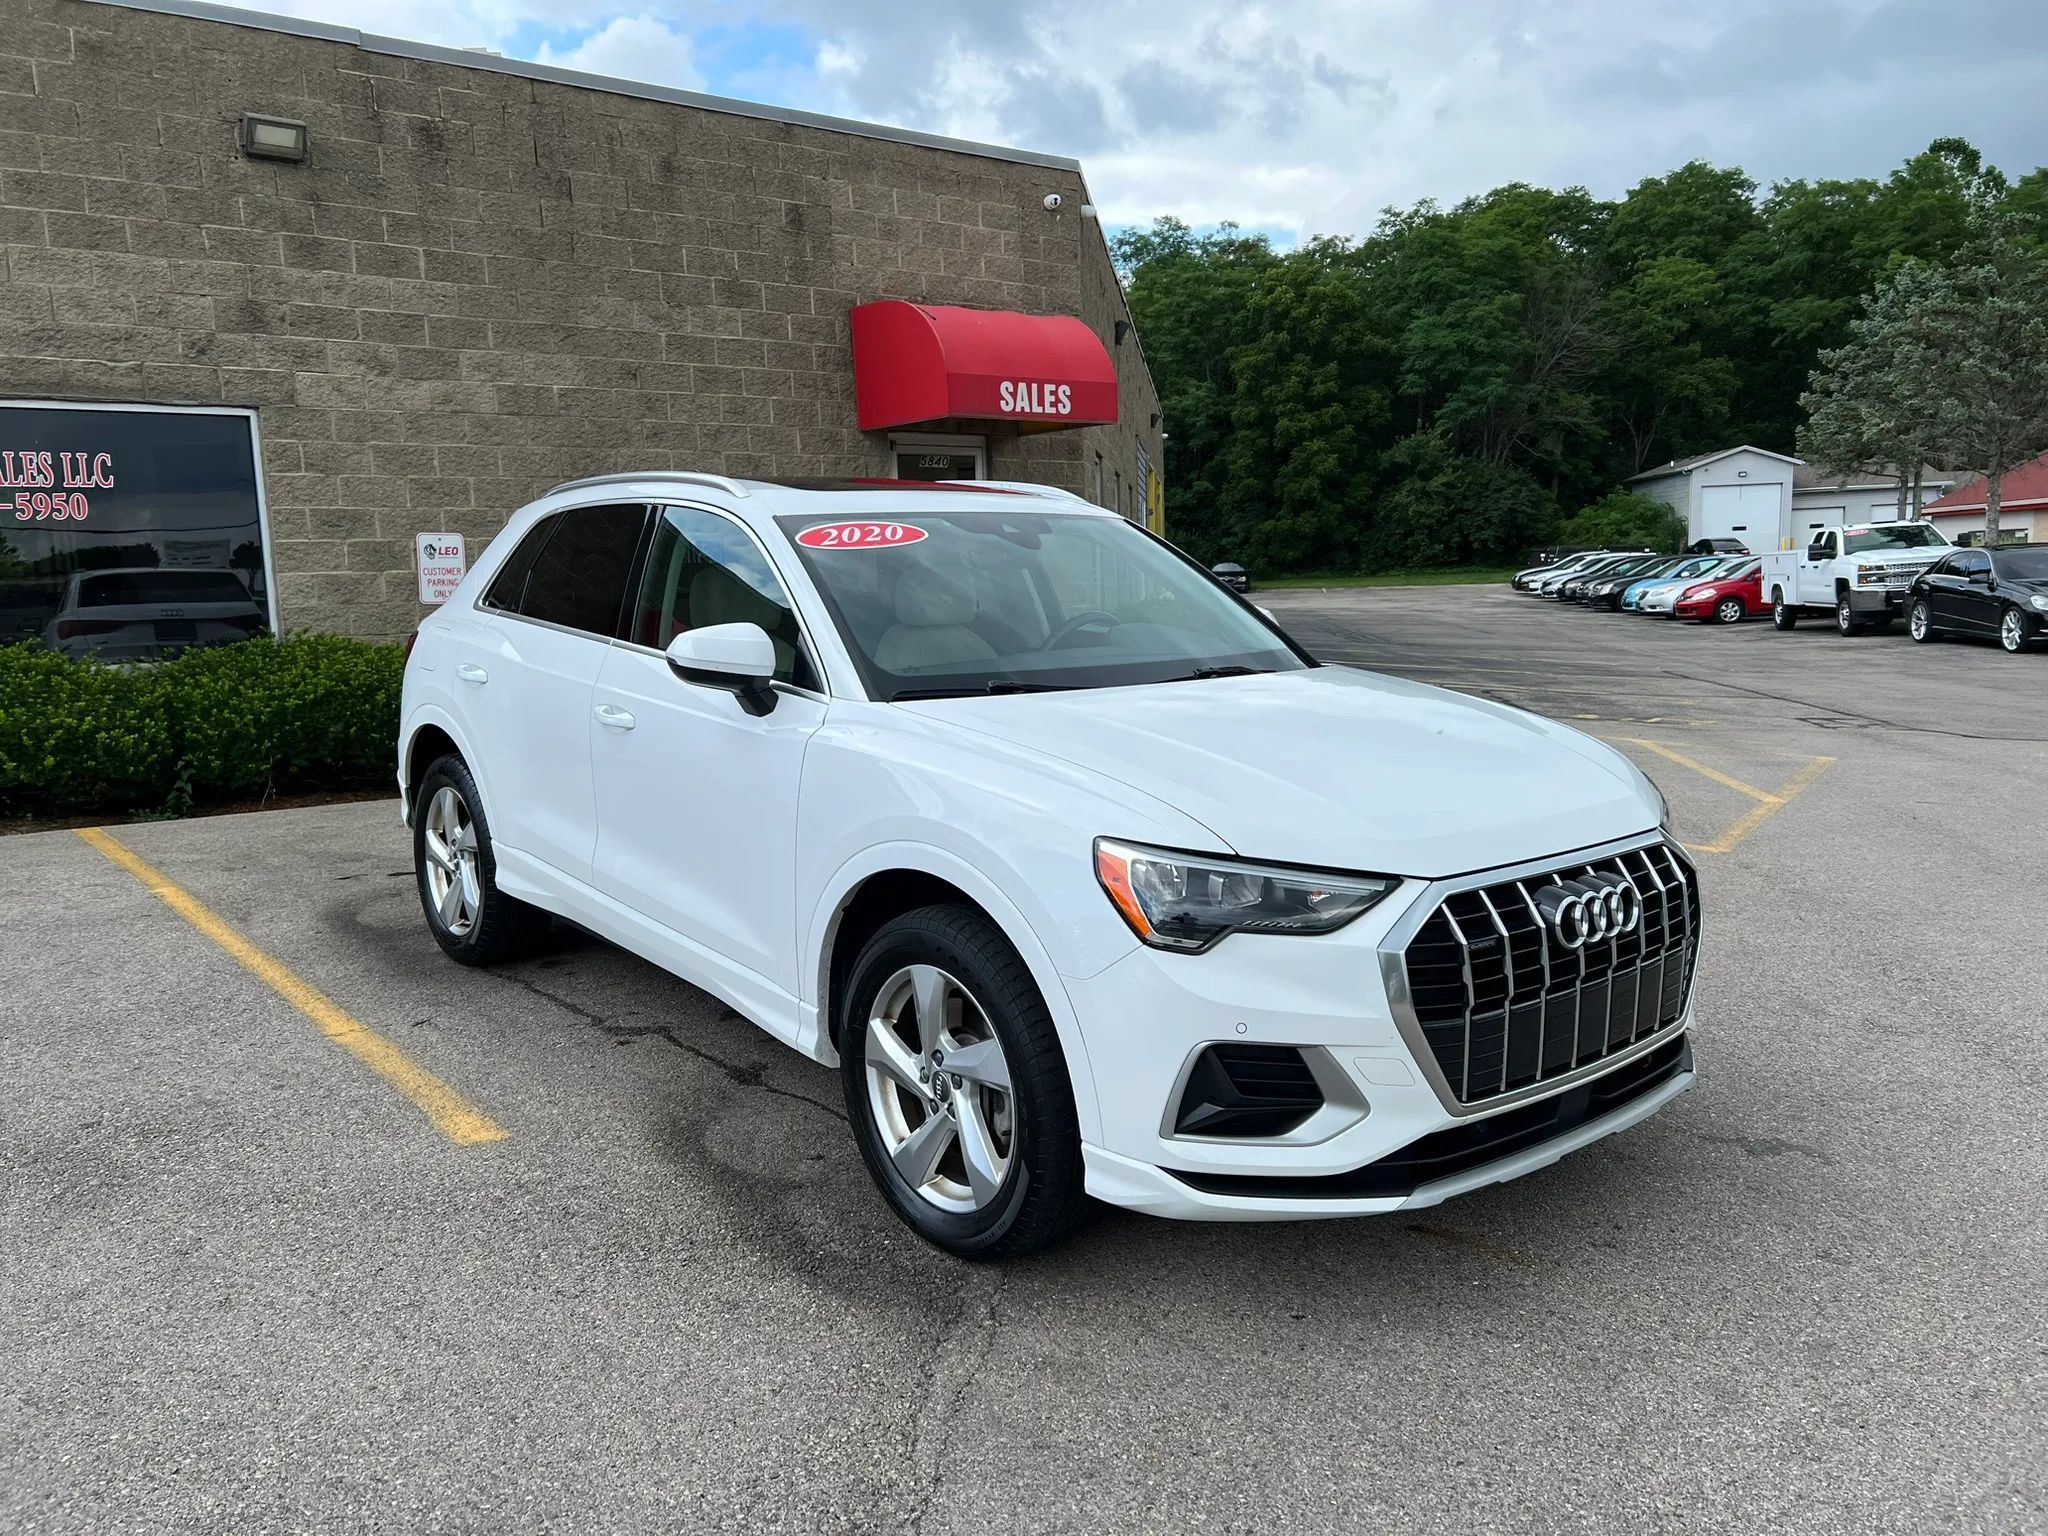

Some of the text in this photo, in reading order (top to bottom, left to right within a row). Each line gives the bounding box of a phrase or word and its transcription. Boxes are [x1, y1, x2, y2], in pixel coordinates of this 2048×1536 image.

[999, 380, 1072, 415] SALES
[920, 456, 949, 467] 5840
[60, 452, 114, 488] LLC
[819, 525, 904, 546] 2020
[438, 546, 459, 556] LEO
[423, 567, 462, 576] CUSTOMER
[427, 578, 459, 587] PARKING
[433, 589, 453, 598] ONLY
